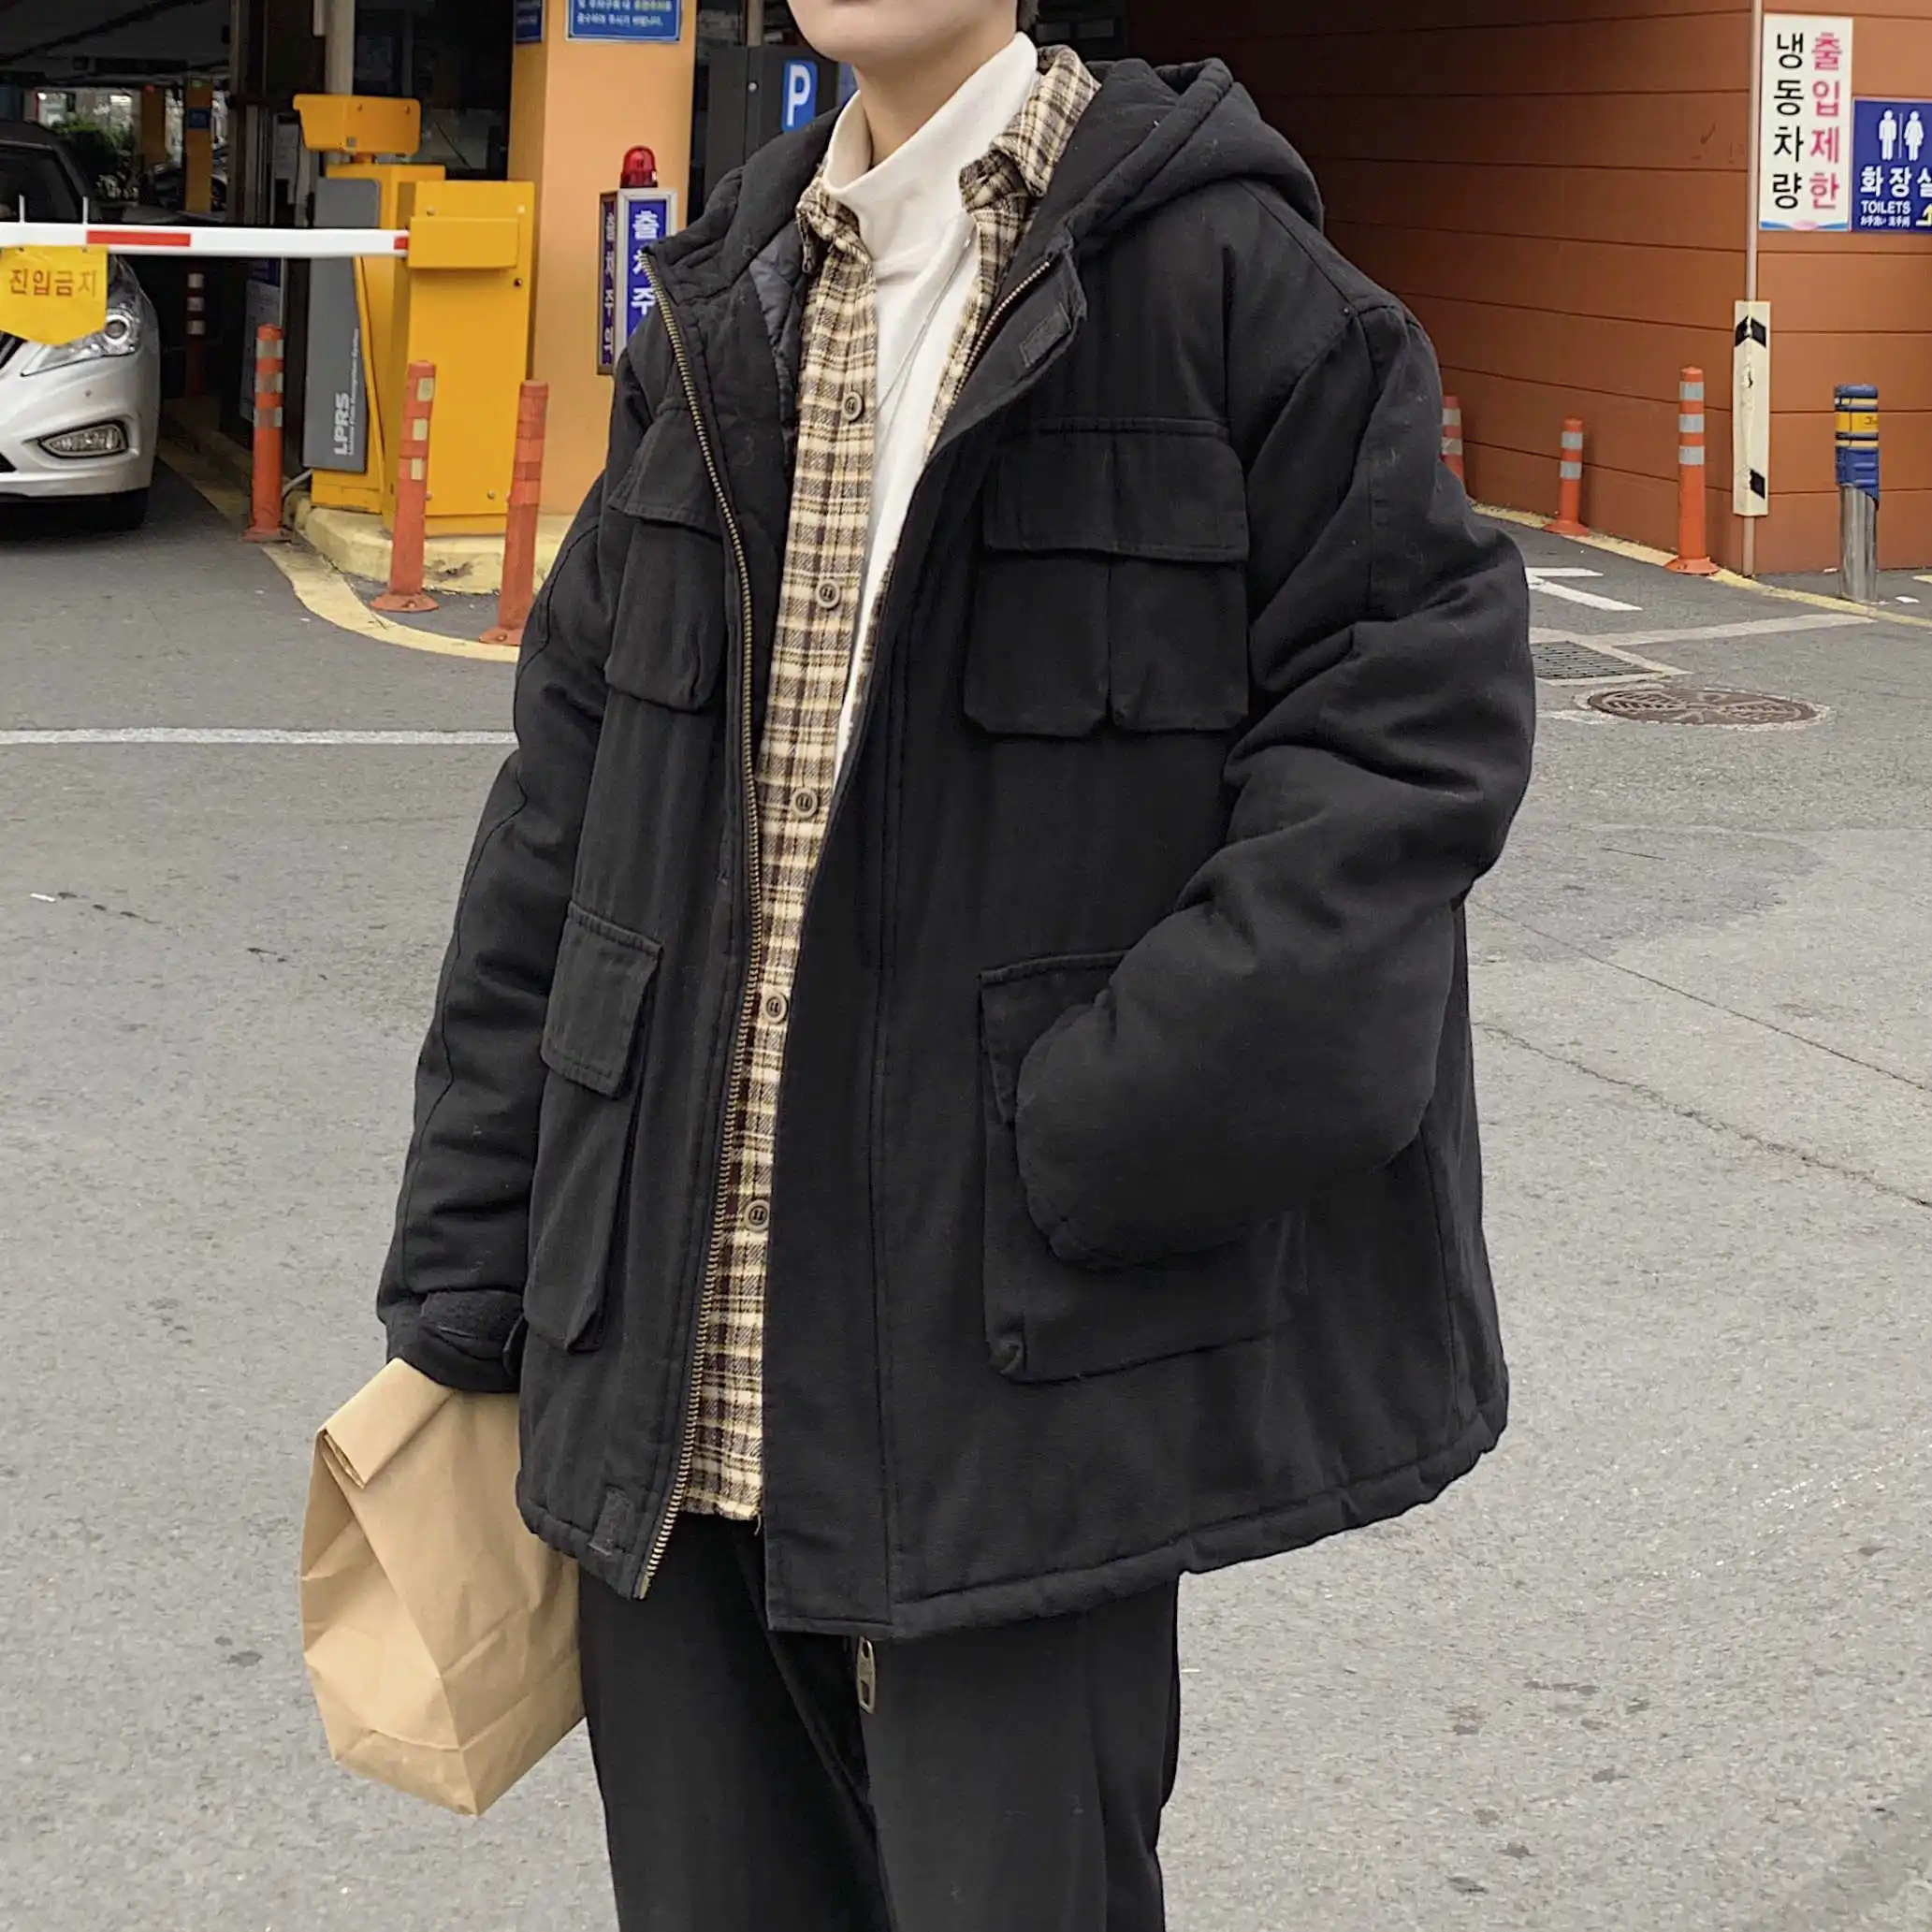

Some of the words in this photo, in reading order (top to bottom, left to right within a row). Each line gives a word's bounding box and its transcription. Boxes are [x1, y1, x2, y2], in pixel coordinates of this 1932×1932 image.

[787, 64, 811, 127] P
[1773, 32, 1804, 209] 냉동차량
[1809, 32, 1842, 210] 출입제한
[1861, 199, 1911, 215] TOILETS
[9, 268, 96, 298] 진입금지
[334, 392, 350, 456] LPRS
